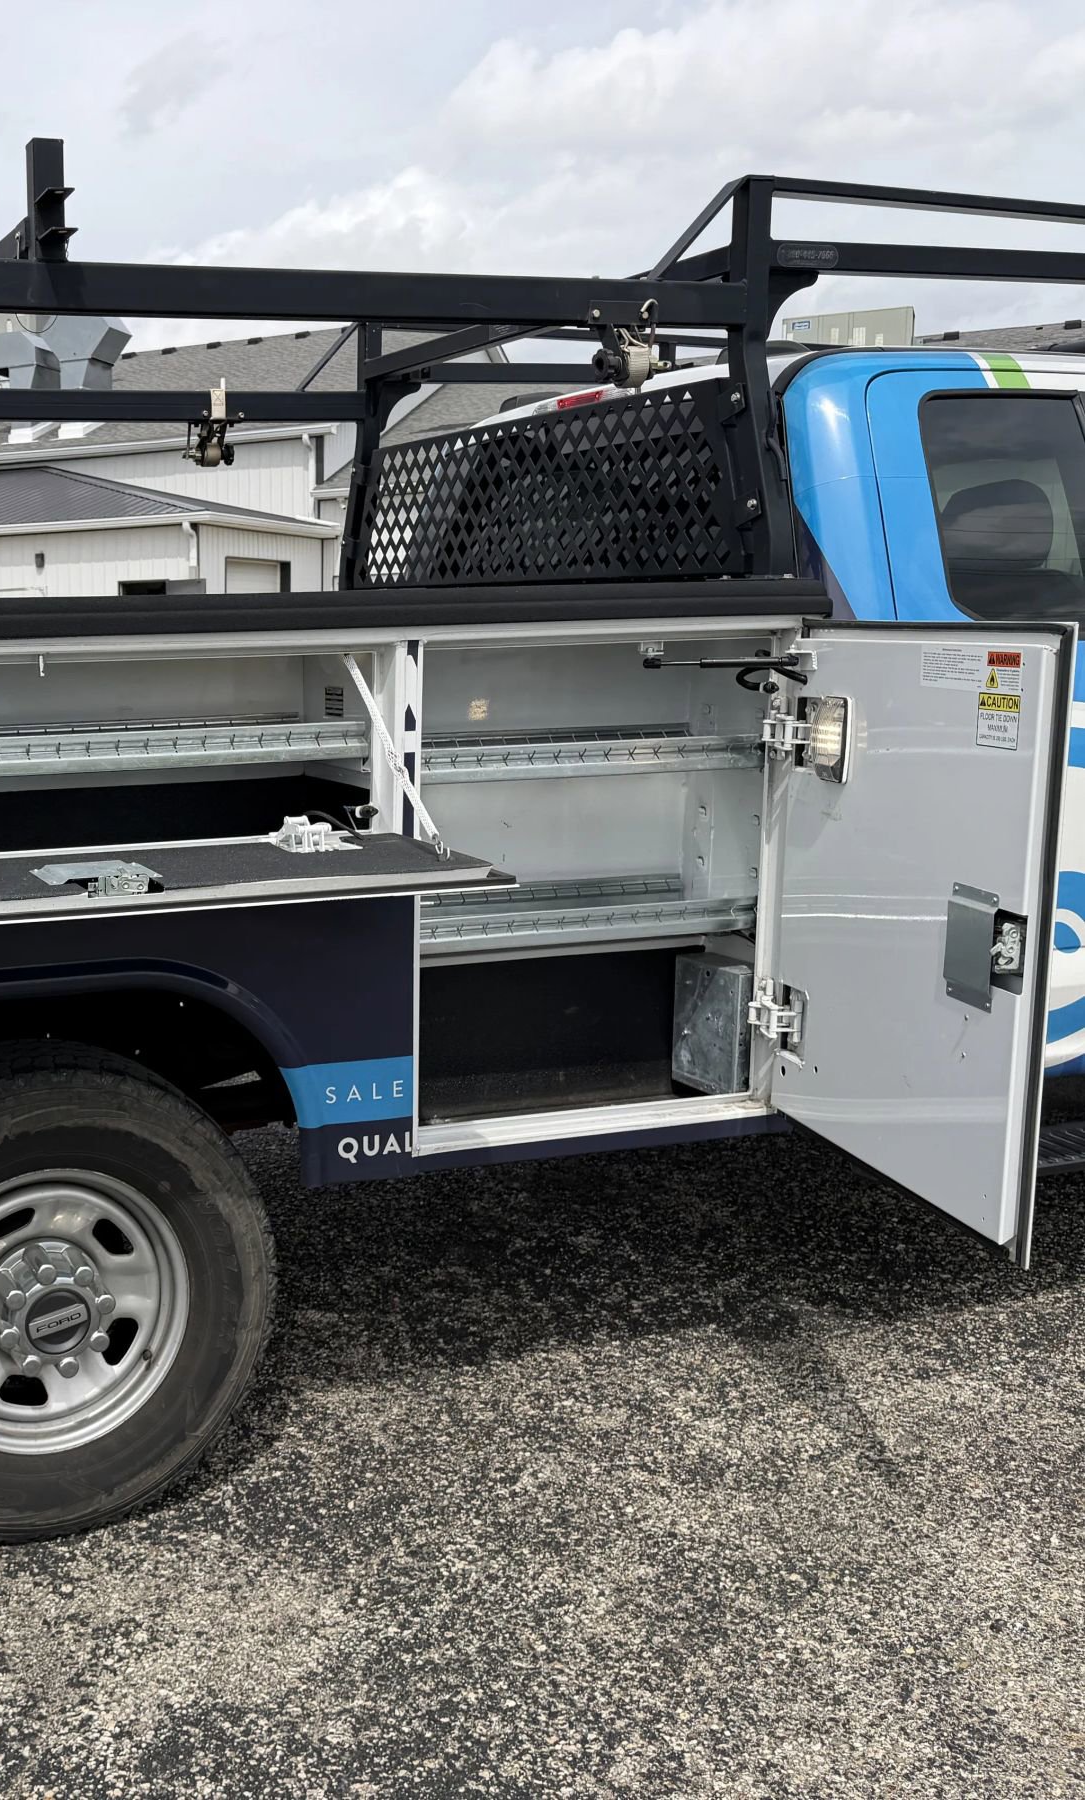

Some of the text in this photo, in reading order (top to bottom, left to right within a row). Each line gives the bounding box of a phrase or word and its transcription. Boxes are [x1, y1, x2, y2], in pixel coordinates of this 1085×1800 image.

[995, 653, 1020, 666] WARNING
[986, 696, 1019, 710] CAUTION
[980, 712, 1018, 724] FLOOR TIE DOWN
[325, 1079, 404, 1104] SALE
[35, 1312, 82, 1334] FORD
